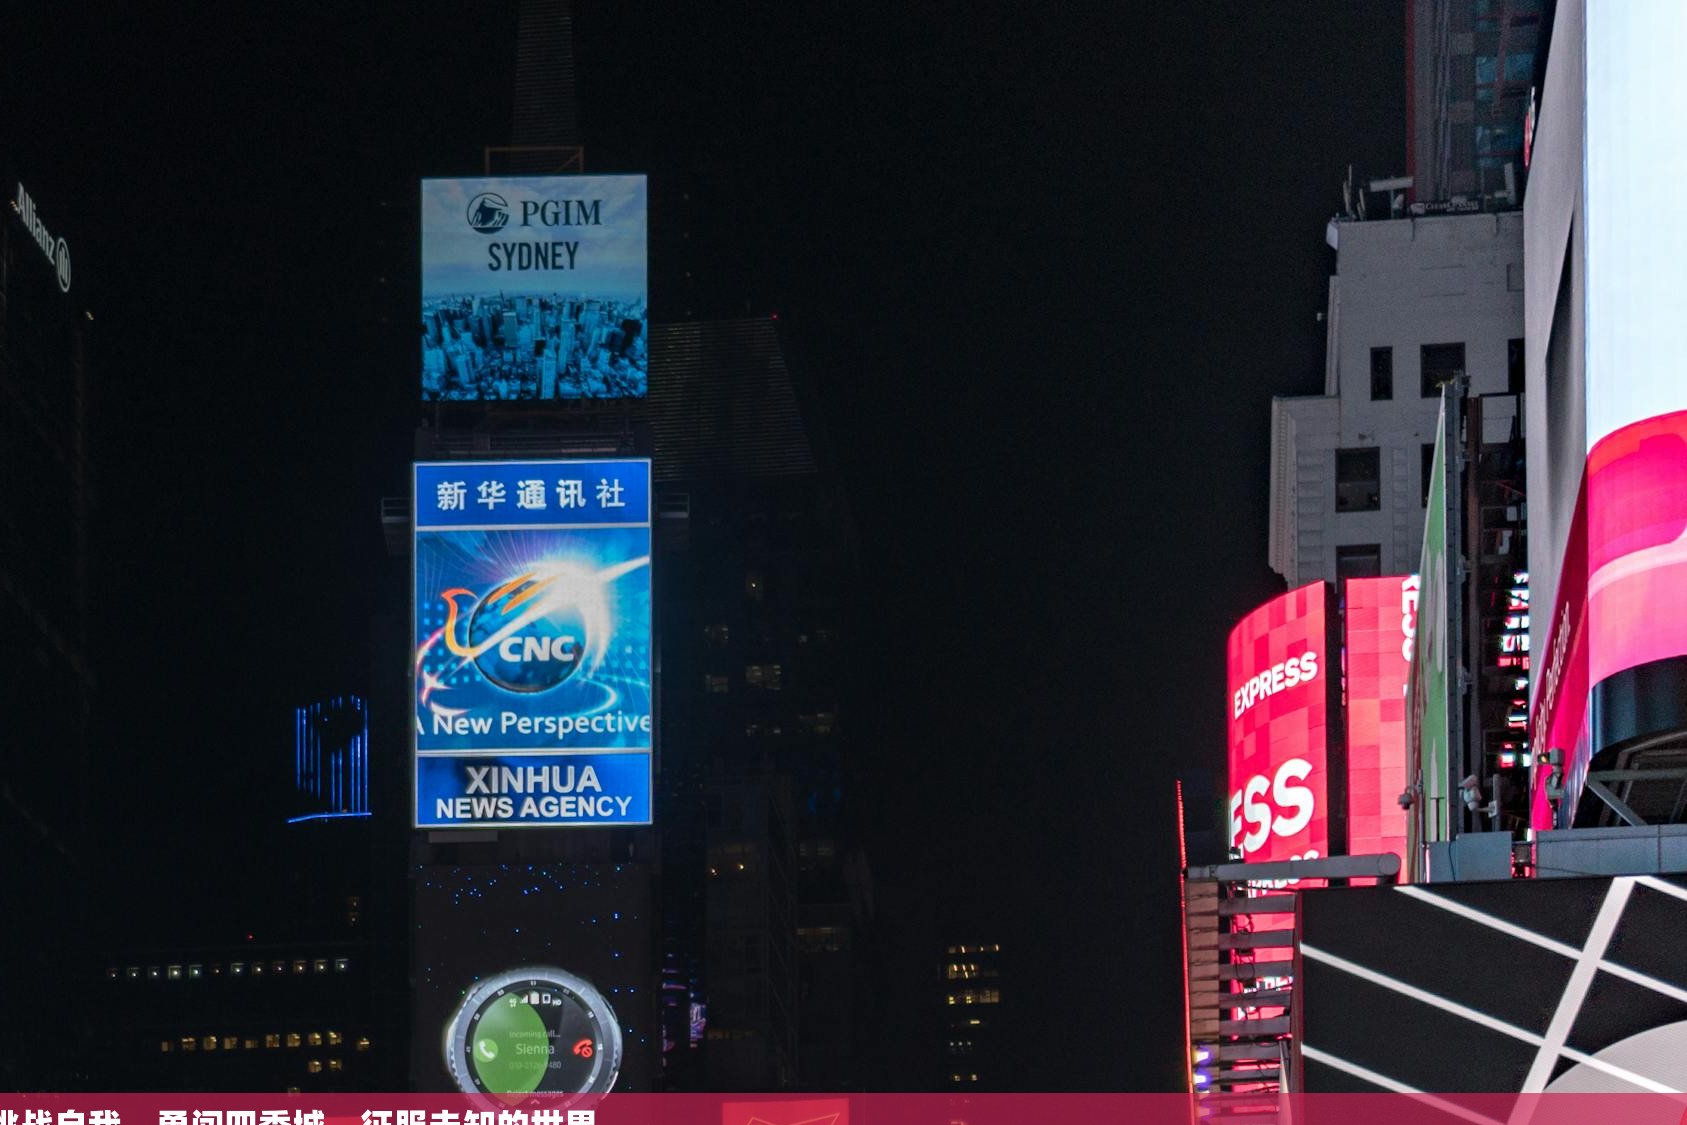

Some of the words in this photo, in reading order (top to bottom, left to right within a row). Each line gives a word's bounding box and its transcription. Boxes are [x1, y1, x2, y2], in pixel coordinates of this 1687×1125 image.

[16, 182, 56, 266] Allianz
[520, 199, 603, 228] PGIM
[487, 241, 580, 272] SYDNEY
[436, 478, 627, 512] 新华通讯社
[498, 635, 576, 662] CNC
[1234, 651, 1318, 721] EXPRESS
[433, 712, 493, 736] New
[501, 711, 651, 740] Perspective
[466, 765, 602, 795] XINHUA
[435, 798, 514, 820] NEWS
[520, 796, 633, 819] AGENCY
[515, 1043, 555, 1055] Sienna
